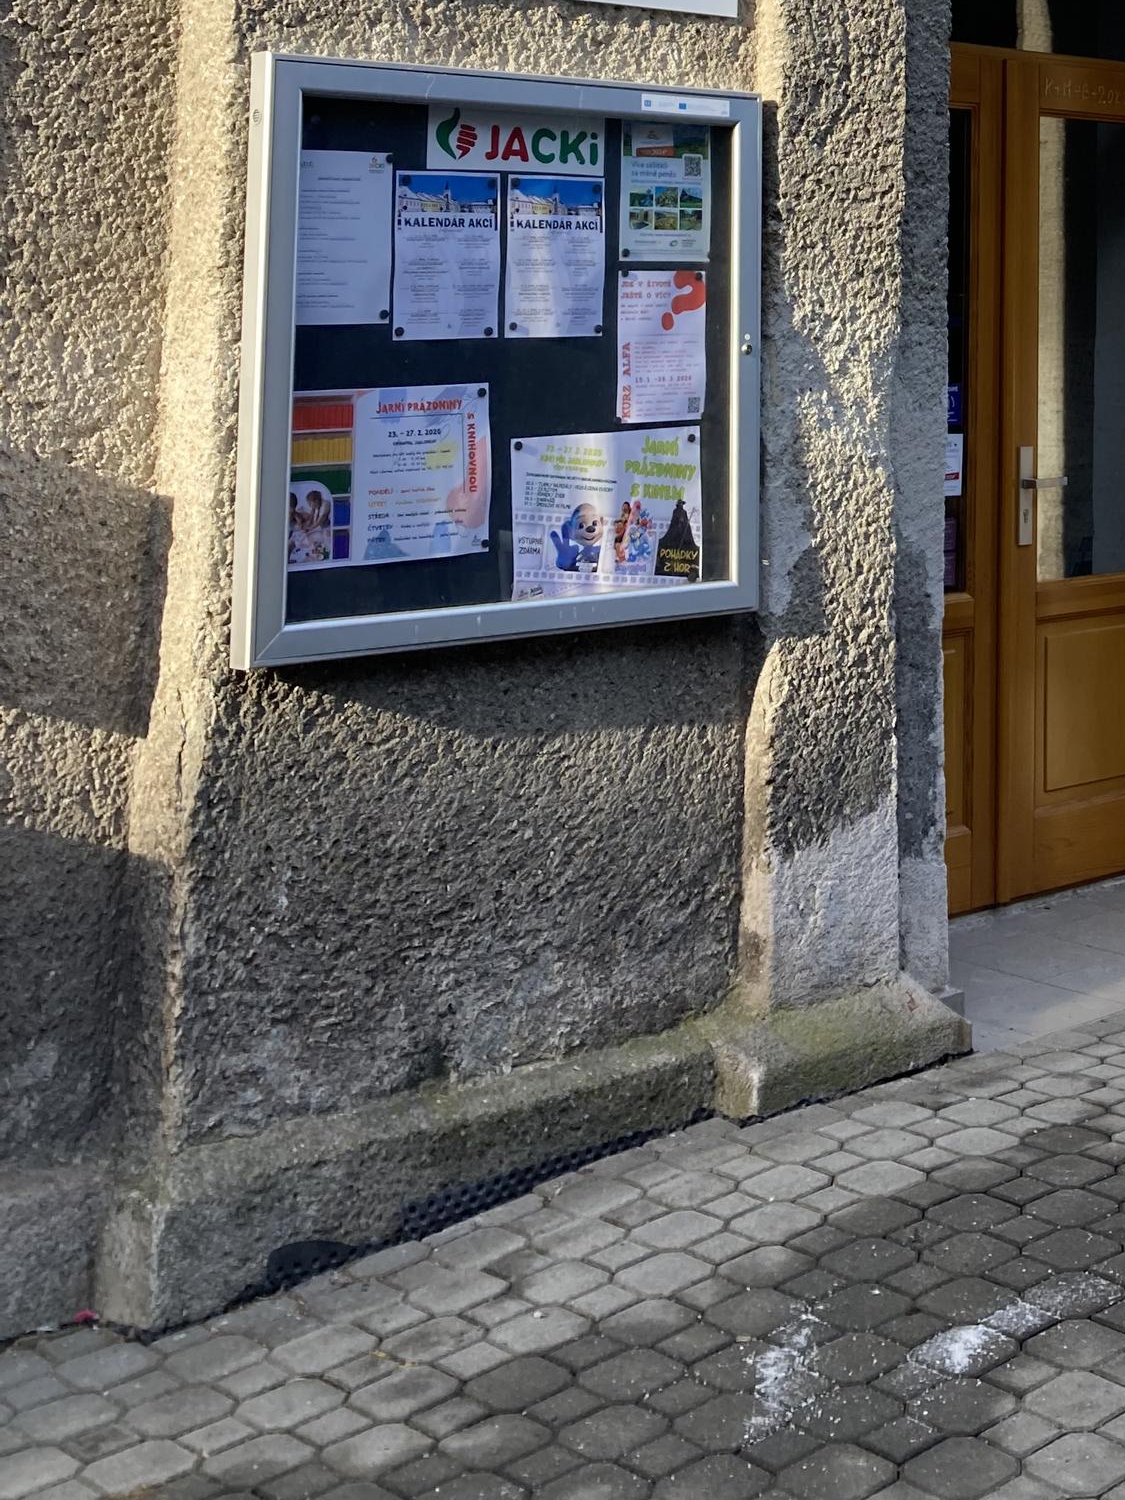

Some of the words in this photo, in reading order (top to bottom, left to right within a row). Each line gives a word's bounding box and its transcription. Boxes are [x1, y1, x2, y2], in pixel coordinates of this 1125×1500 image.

[468, 215, 493, 228] AKCÍ
[622, 342, 632, 376] ALFA
[376, 399, 405, 414] JARNÍ
[408, 397, 463, 413] PRÁZDNINY
[621, 384, 632, 419] KURZ
[467, 423, 478, 493] KNIHOVNOU
